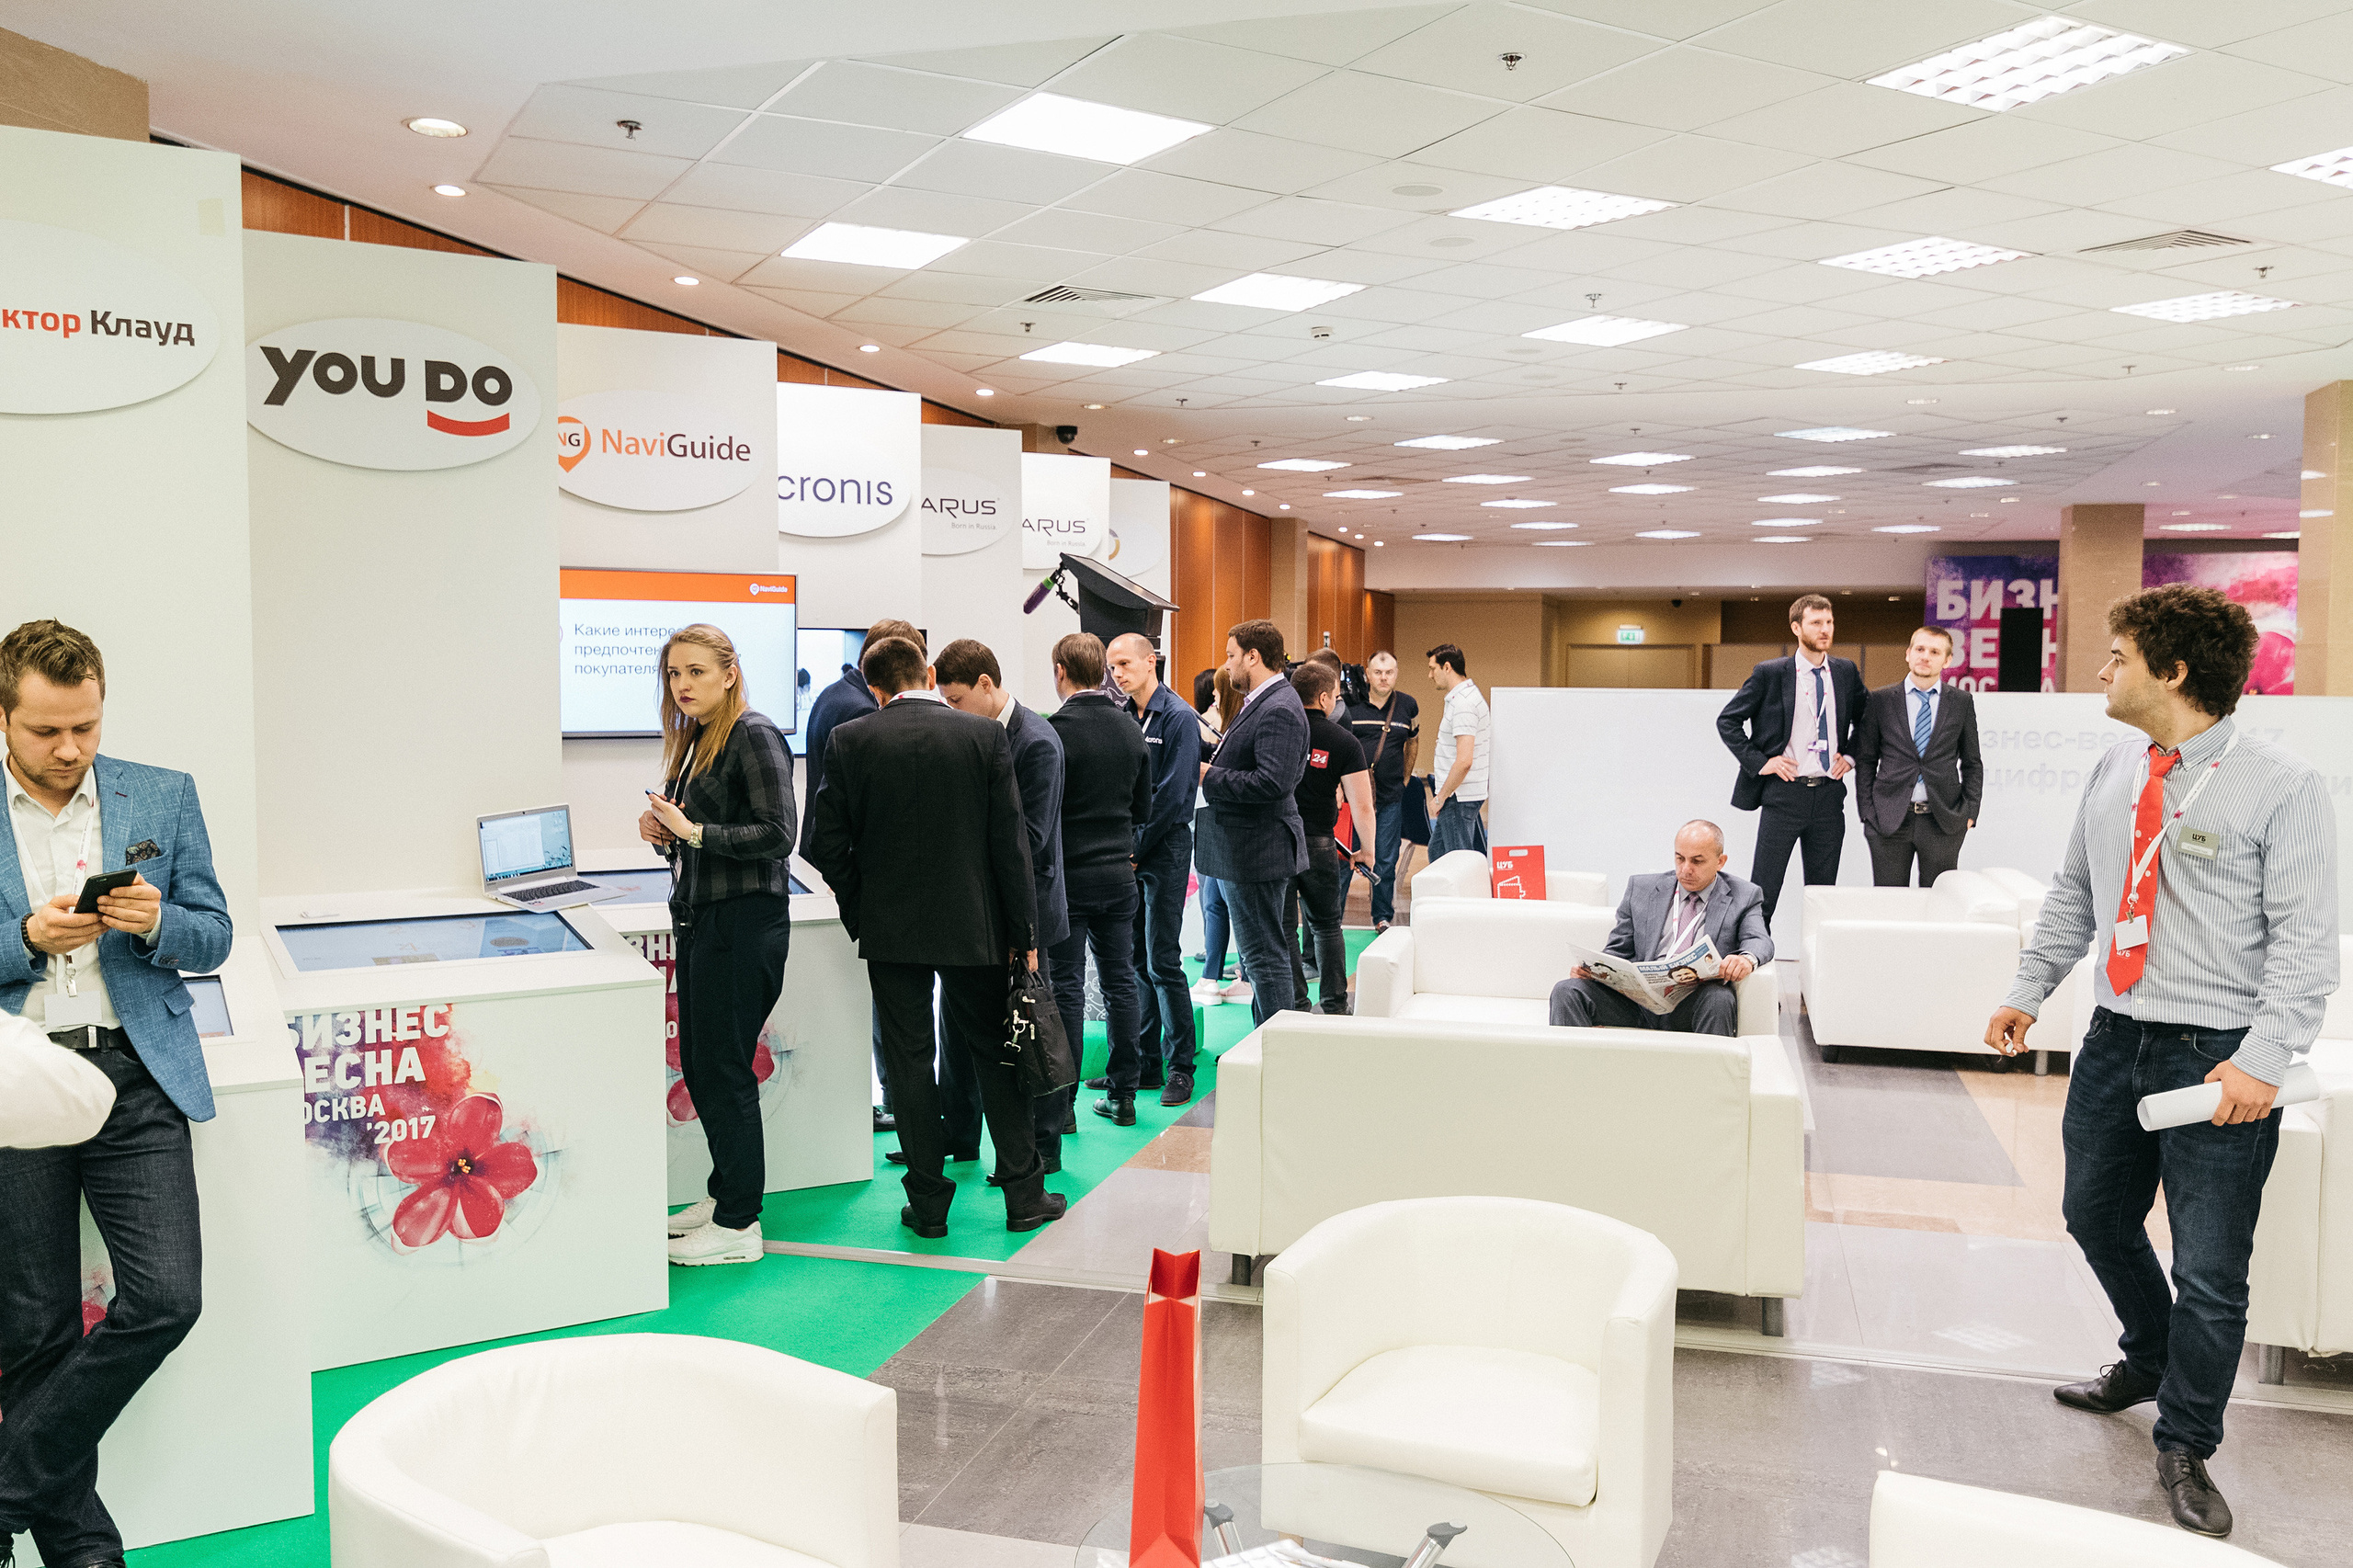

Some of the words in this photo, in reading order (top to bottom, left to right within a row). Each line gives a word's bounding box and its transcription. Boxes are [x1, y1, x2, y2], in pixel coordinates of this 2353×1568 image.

[1, 308, 82, 339] ктор
[90, 309, 196, 347] Клауд
[424, 359, 513, 406] DO
[602, 428, 751, 461] NaviGuide
[778, 475, 893, 506] cronis
[921, 497, 996, 518] ARUS
[1022, 518, 1086, 537] ARUS
[1936, 579, 2058, 620] БИЗН
[574, 623, 620, 637] Какие
[574, 645, 662, 658] предпочтен
[1312, 754, 1327, 765] 24
[1496, 860, 1514, 869] ЦУБ
[304, 1046, 426, 1094] ЕСНА
[303, 1093, 386, 1125] ОСКВА
